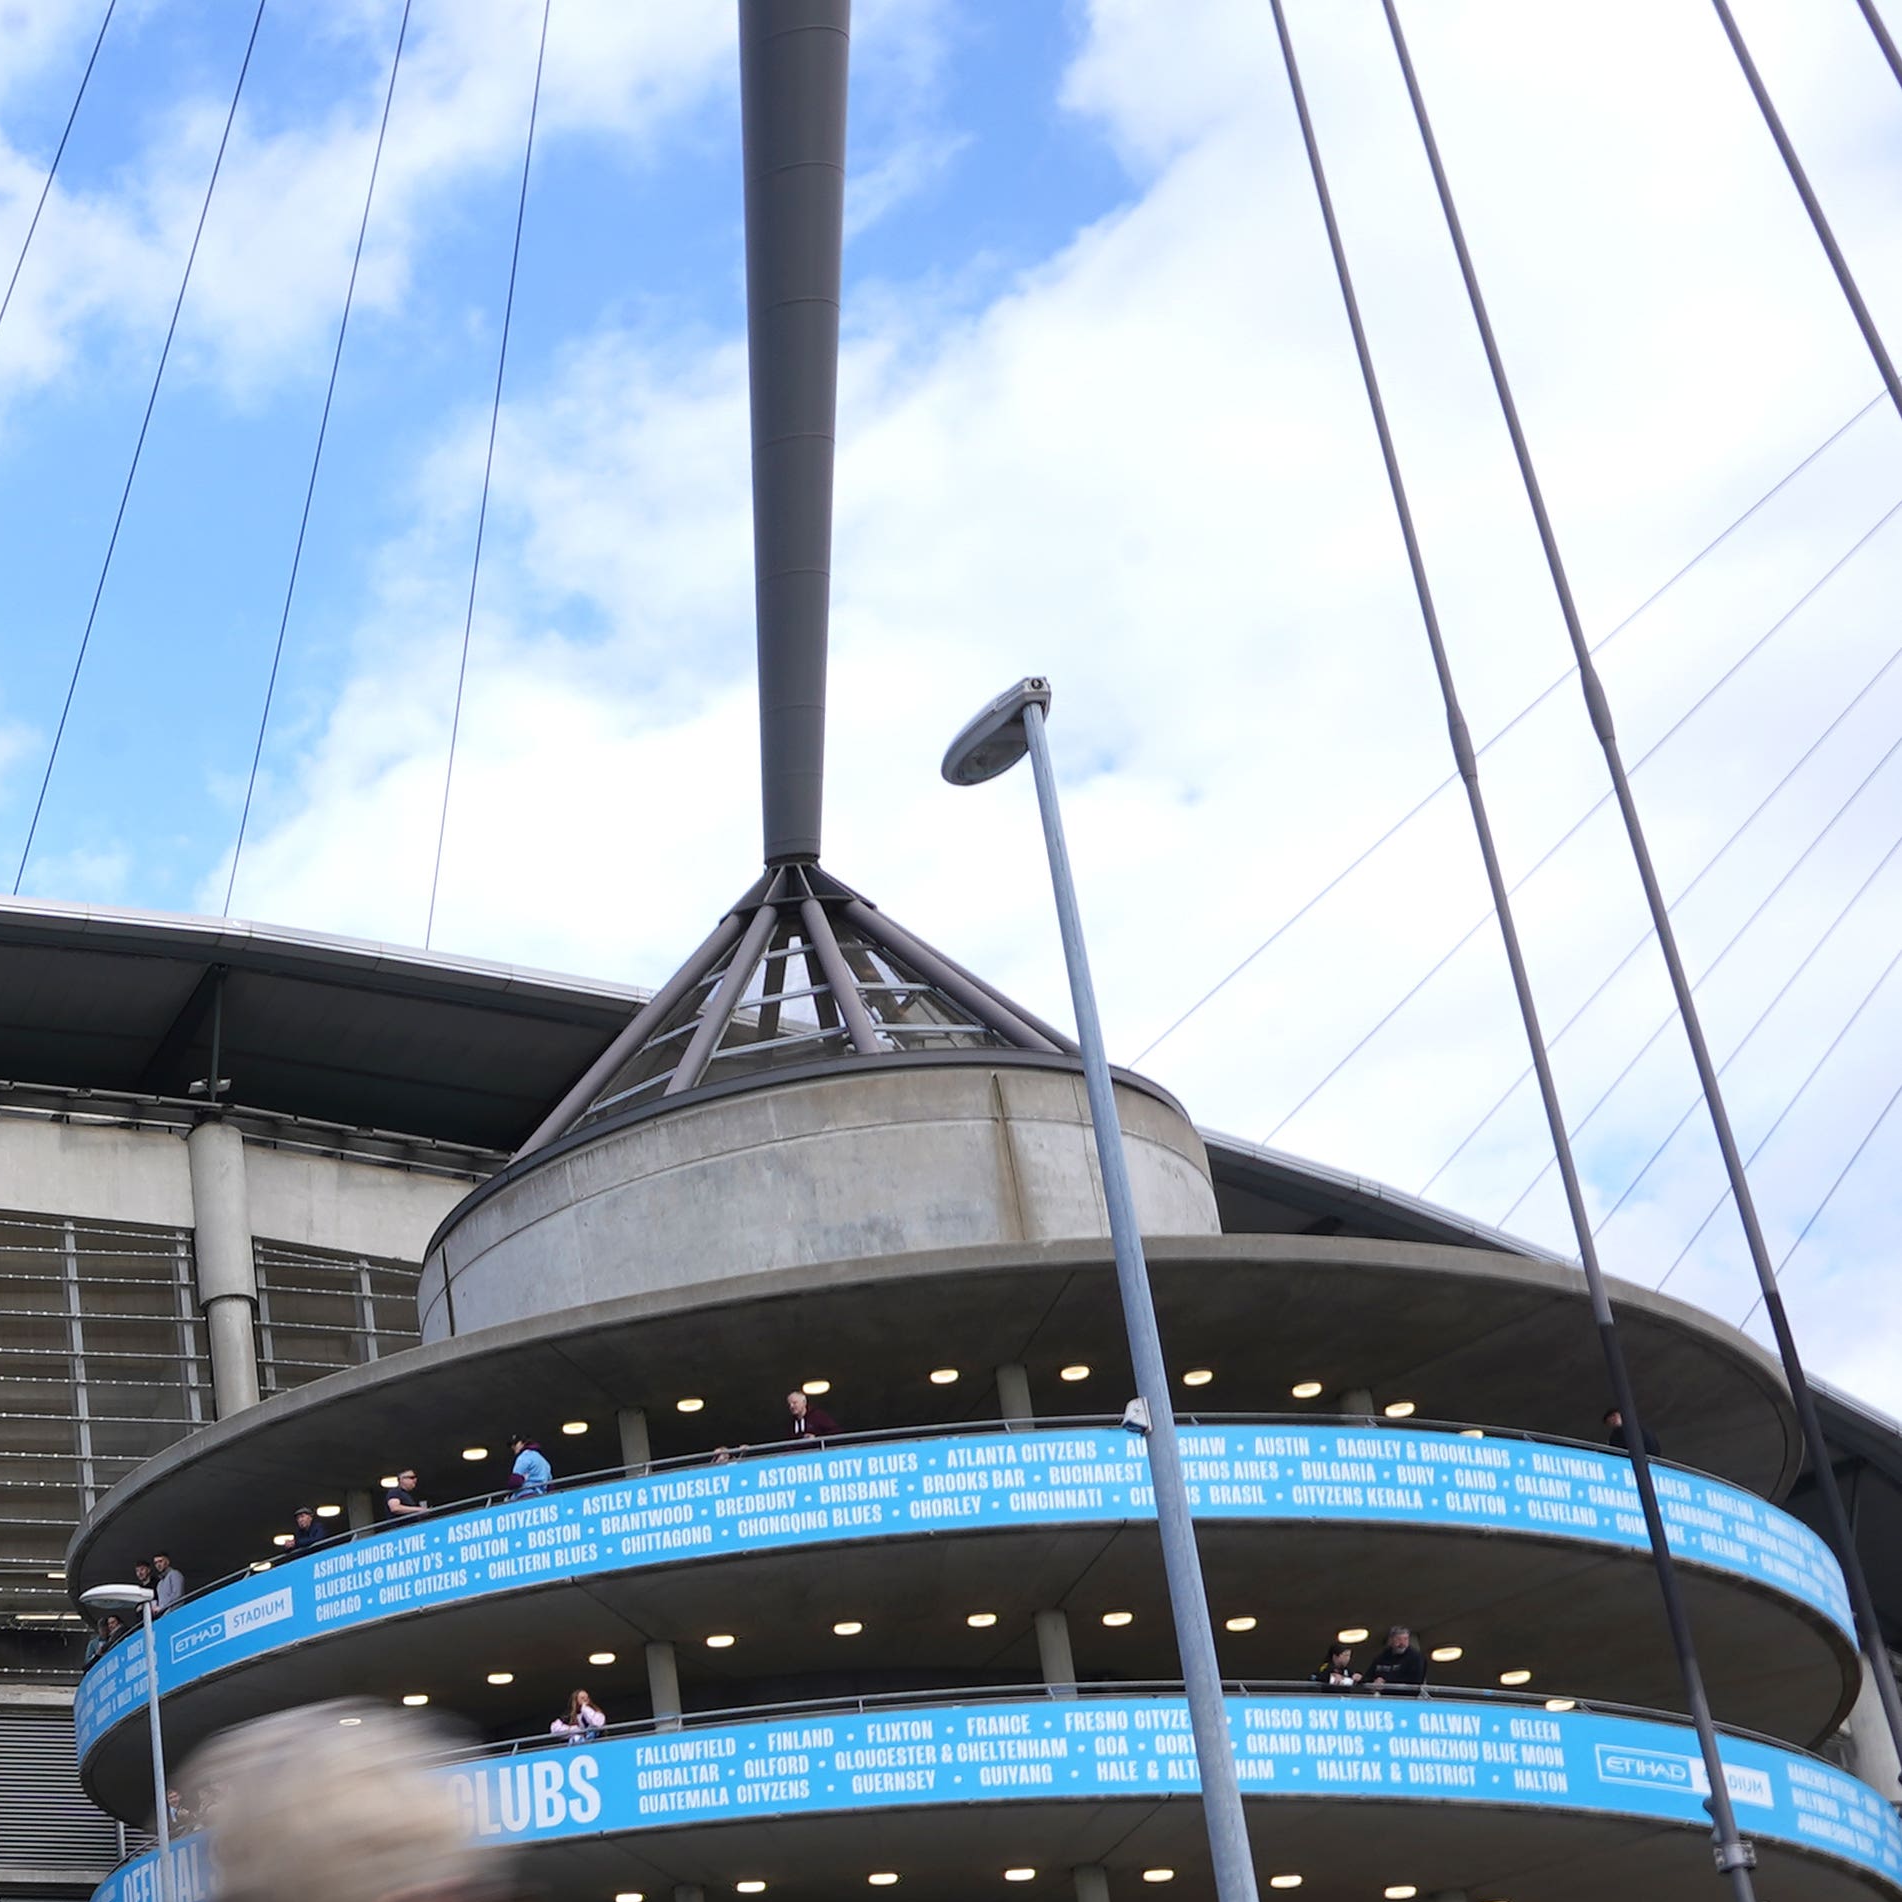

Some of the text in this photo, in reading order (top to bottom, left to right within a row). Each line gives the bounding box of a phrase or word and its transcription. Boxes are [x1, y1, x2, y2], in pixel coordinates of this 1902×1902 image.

[313, 1437, 1511, 1580] ASHTON-UNDER-LYNE ASSAM CITYZENS ASTLEY TYLDESLEY ASTORIA CITY BLUES ATLANTA CITYZENS AUSTIN BAGULEY BROOKLANDS
[314, 1460, 1497, 1602] BLUEBELLS MARY BOLTON BOSTON BRANTWOOD BREDBURY BRISBANE BROOKS BAR BUCHAREST AIRES BULGARIA BURY CAIRO
[315, 1485, 1507, 1623] CHICAGO CHILE CITIZENS CHILTERN BLUES CHITTAGONG CHONGQING BLUES CHORLEY CINCINNATI BRASIL CITYZENS KERALA CLAYTON
[174, 1598, 286, 1653] ETIHAD STADIUM
[636, 1708, 1481, 1767] FALLOWFIELD FINLAND FLIXTON FRANCE FRESNO FRISCO SKY BLUES GALWAY
[637, 1733, 1565, 1791] GIBRALTAR GILFORD GLOUCESTER CHELTENHAM GOA GRAND RAPIDS GUANGZHOU BLUE MOON
[447, 1754, 603, 1839] CLUBS
[638, 1760, 1476, 1815] GUATEMALA CITYZENS GUERNSEY GUIYANG HALE HALIFAX DISTRICT
[1605, 1755, 1687, 1782] ETIHAD
